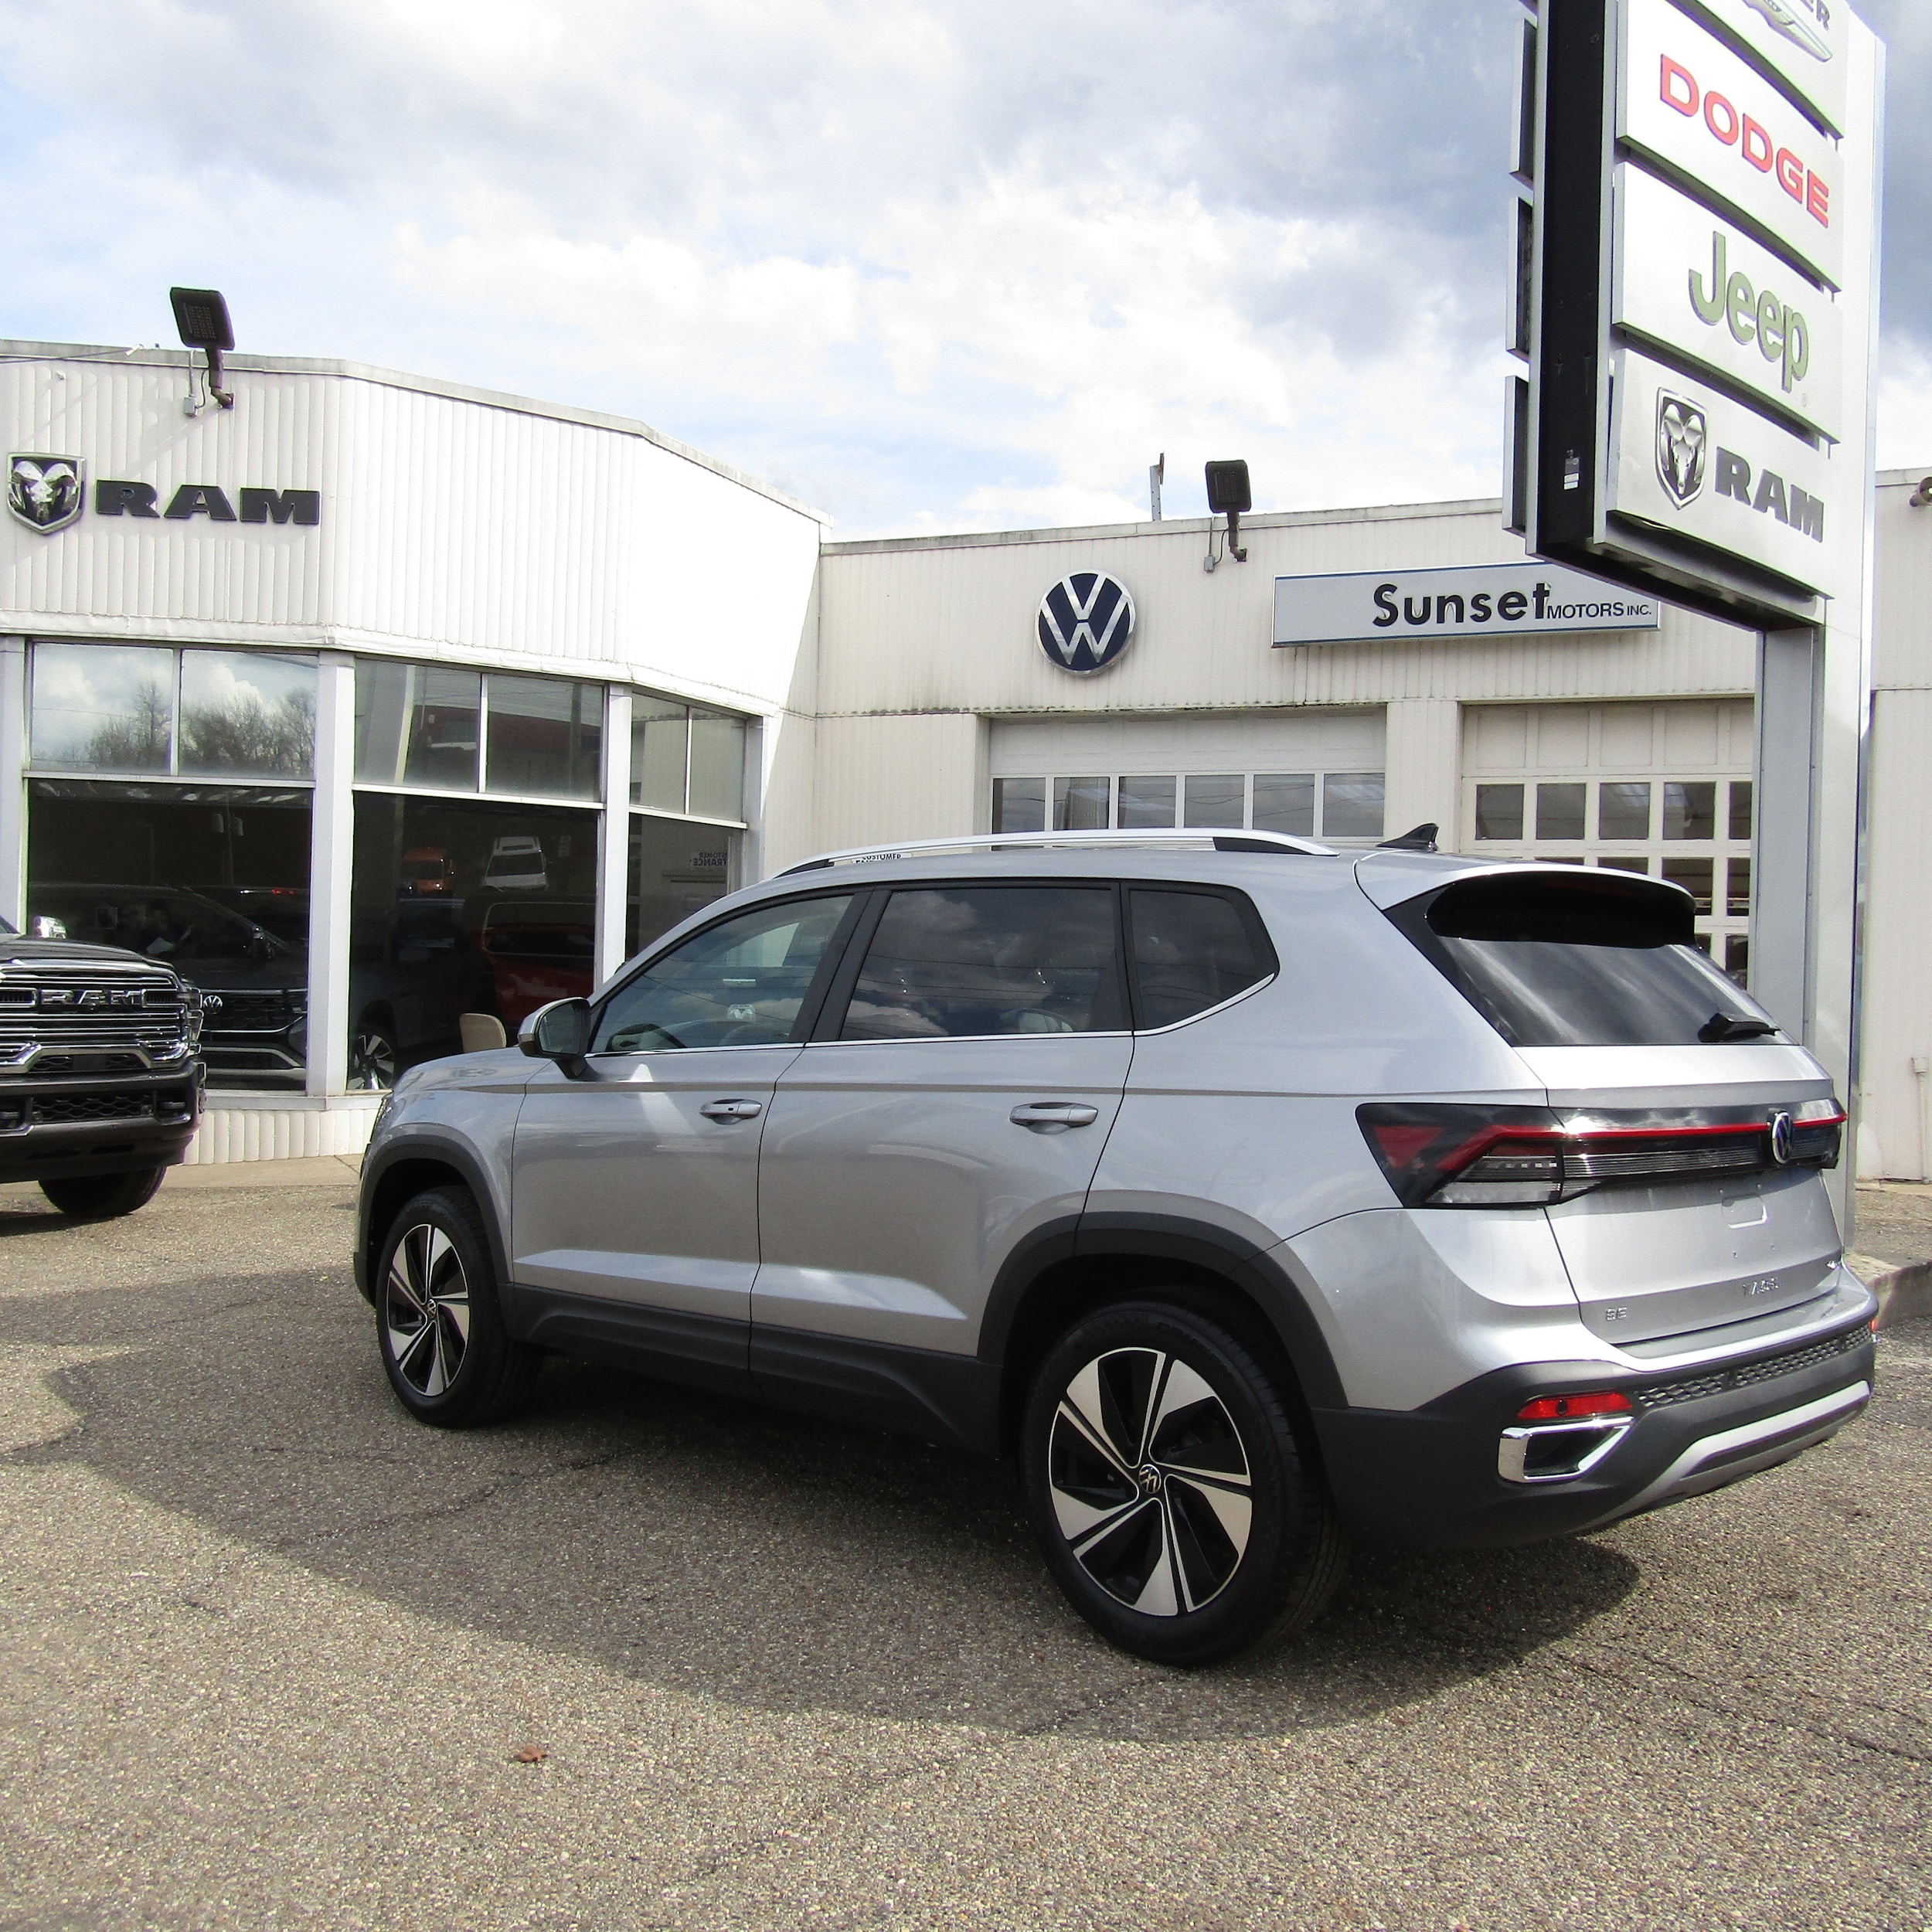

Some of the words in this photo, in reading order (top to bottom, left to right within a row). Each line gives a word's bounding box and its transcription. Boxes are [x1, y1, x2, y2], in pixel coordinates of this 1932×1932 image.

[1660, 53, 1829, 229] DODGE
[1689, 230, 1809, 393] Jeep
[96, 479, 321, 525] RAM
[1715, 446, 1825, 543] RAM
[1372, 582, 1551, 628] Sunset
[1547, 602, 1624, 619] MOTORS
[1627, 604, 1652, 617] INC.
[40, 988, 142, 1005] RAM
[1606, 1307, 1628, 1321] SE
